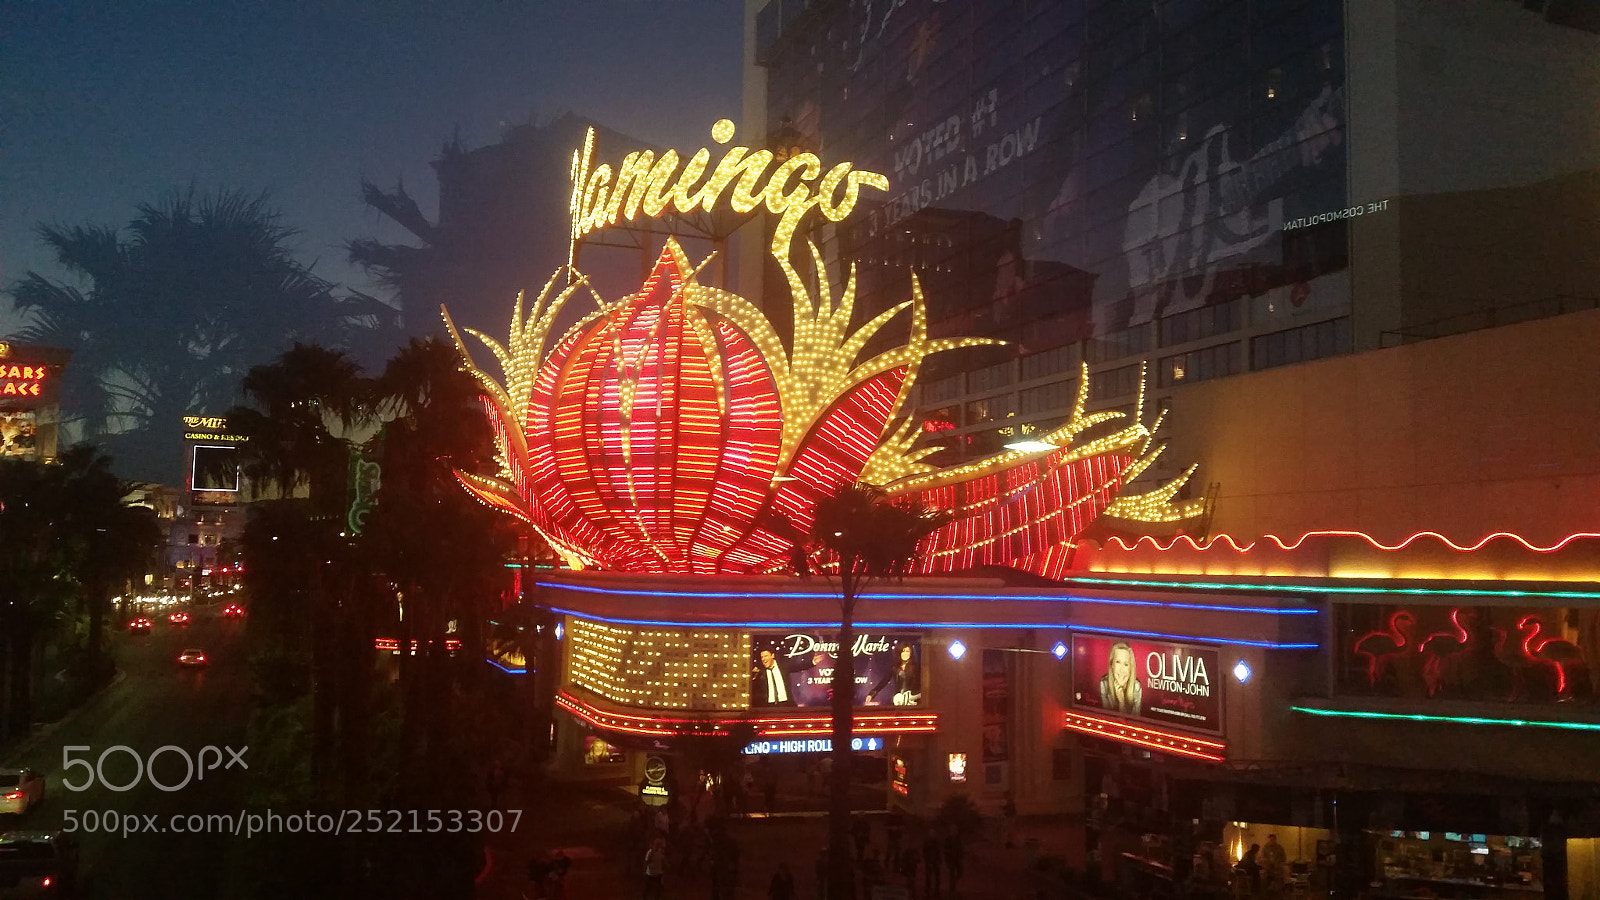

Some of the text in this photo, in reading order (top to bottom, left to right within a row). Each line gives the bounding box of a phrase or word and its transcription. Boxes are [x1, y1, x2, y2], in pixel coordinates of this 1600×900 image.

[894, 87, 999, 182] VOTED #1
[881, 178, 932, 229] YEARS
[935, 163, 958, 201] IN
[961, 154, 979, 188] A
[983, 115, 1042, 176] ROW
[0, 381, 41, 397] ACE
[184, 432, 213, 440] CASINO
[1146, 650, 1210, 686] OLIVIA
[854, 676, 868, 684] OW
[1147, 677, 1211, 697] NEWTON-JOHN
[779, 740, 806, 753] HIGH
